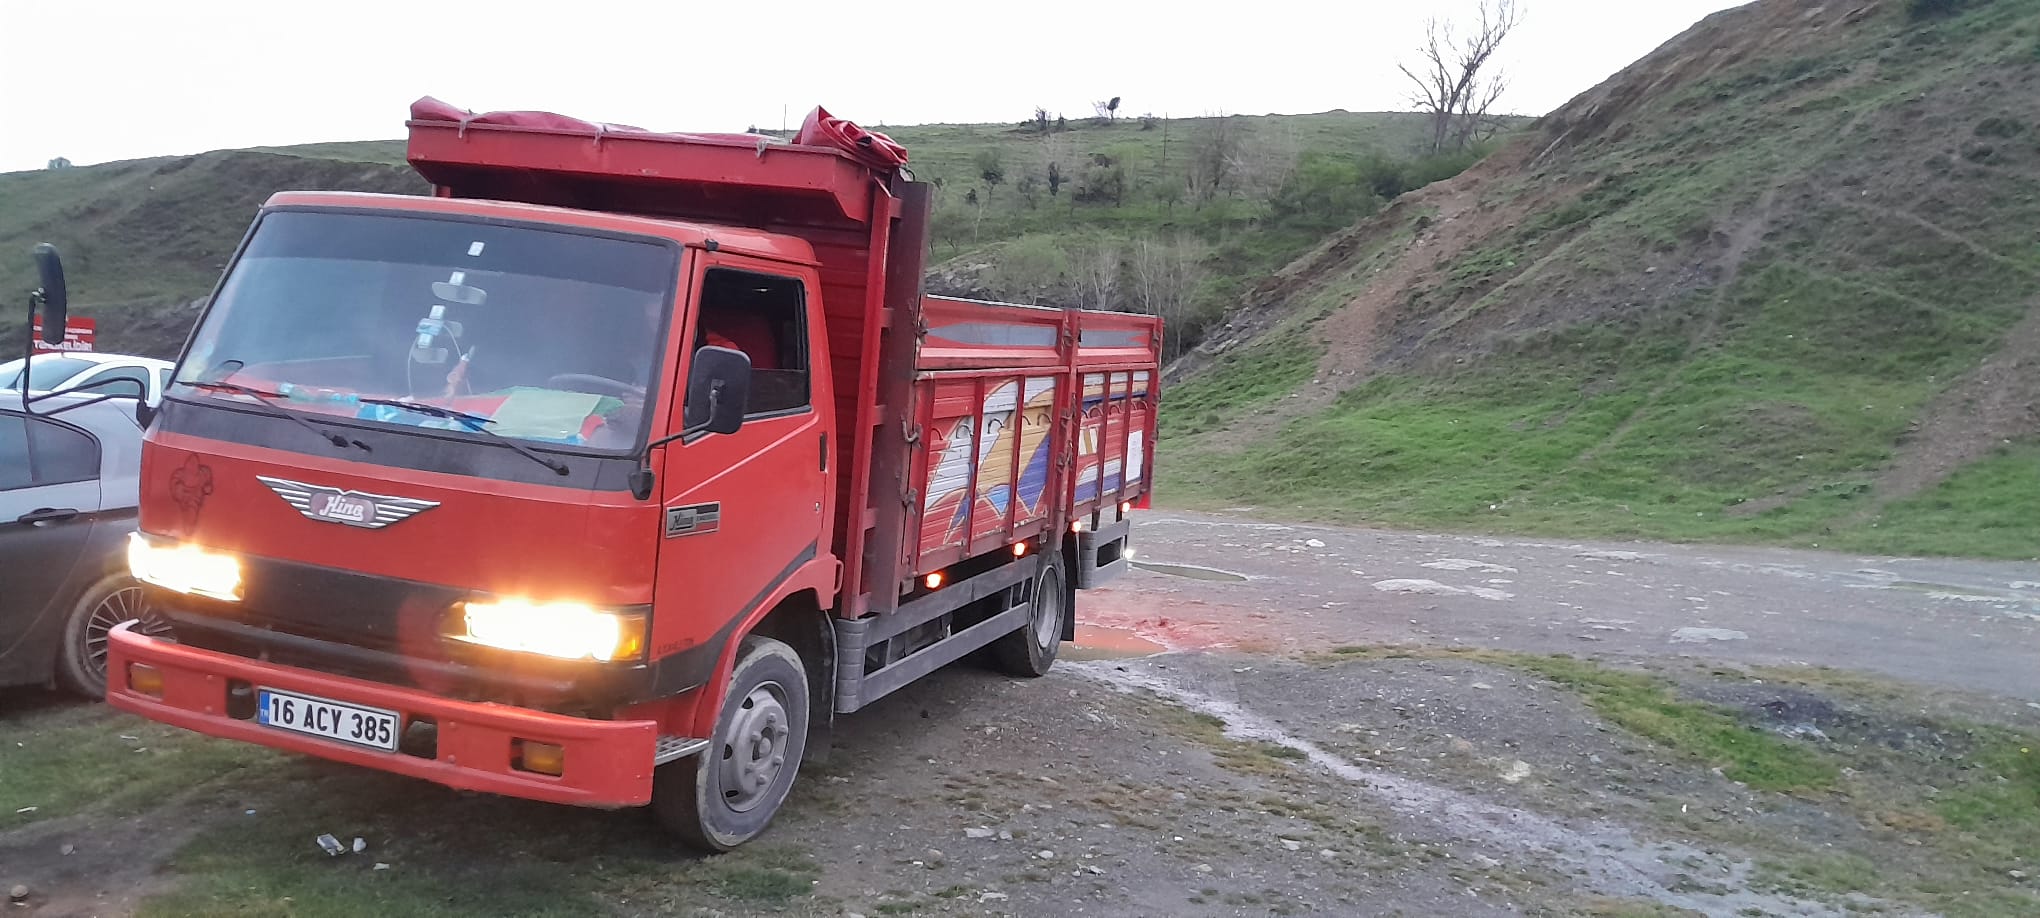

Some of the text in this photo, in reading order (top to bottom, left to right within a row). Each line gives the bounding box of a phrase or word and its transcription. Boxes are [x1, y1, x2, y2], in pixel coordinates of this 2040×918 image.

[271, 697, 391, 744] 16 ACY 385
